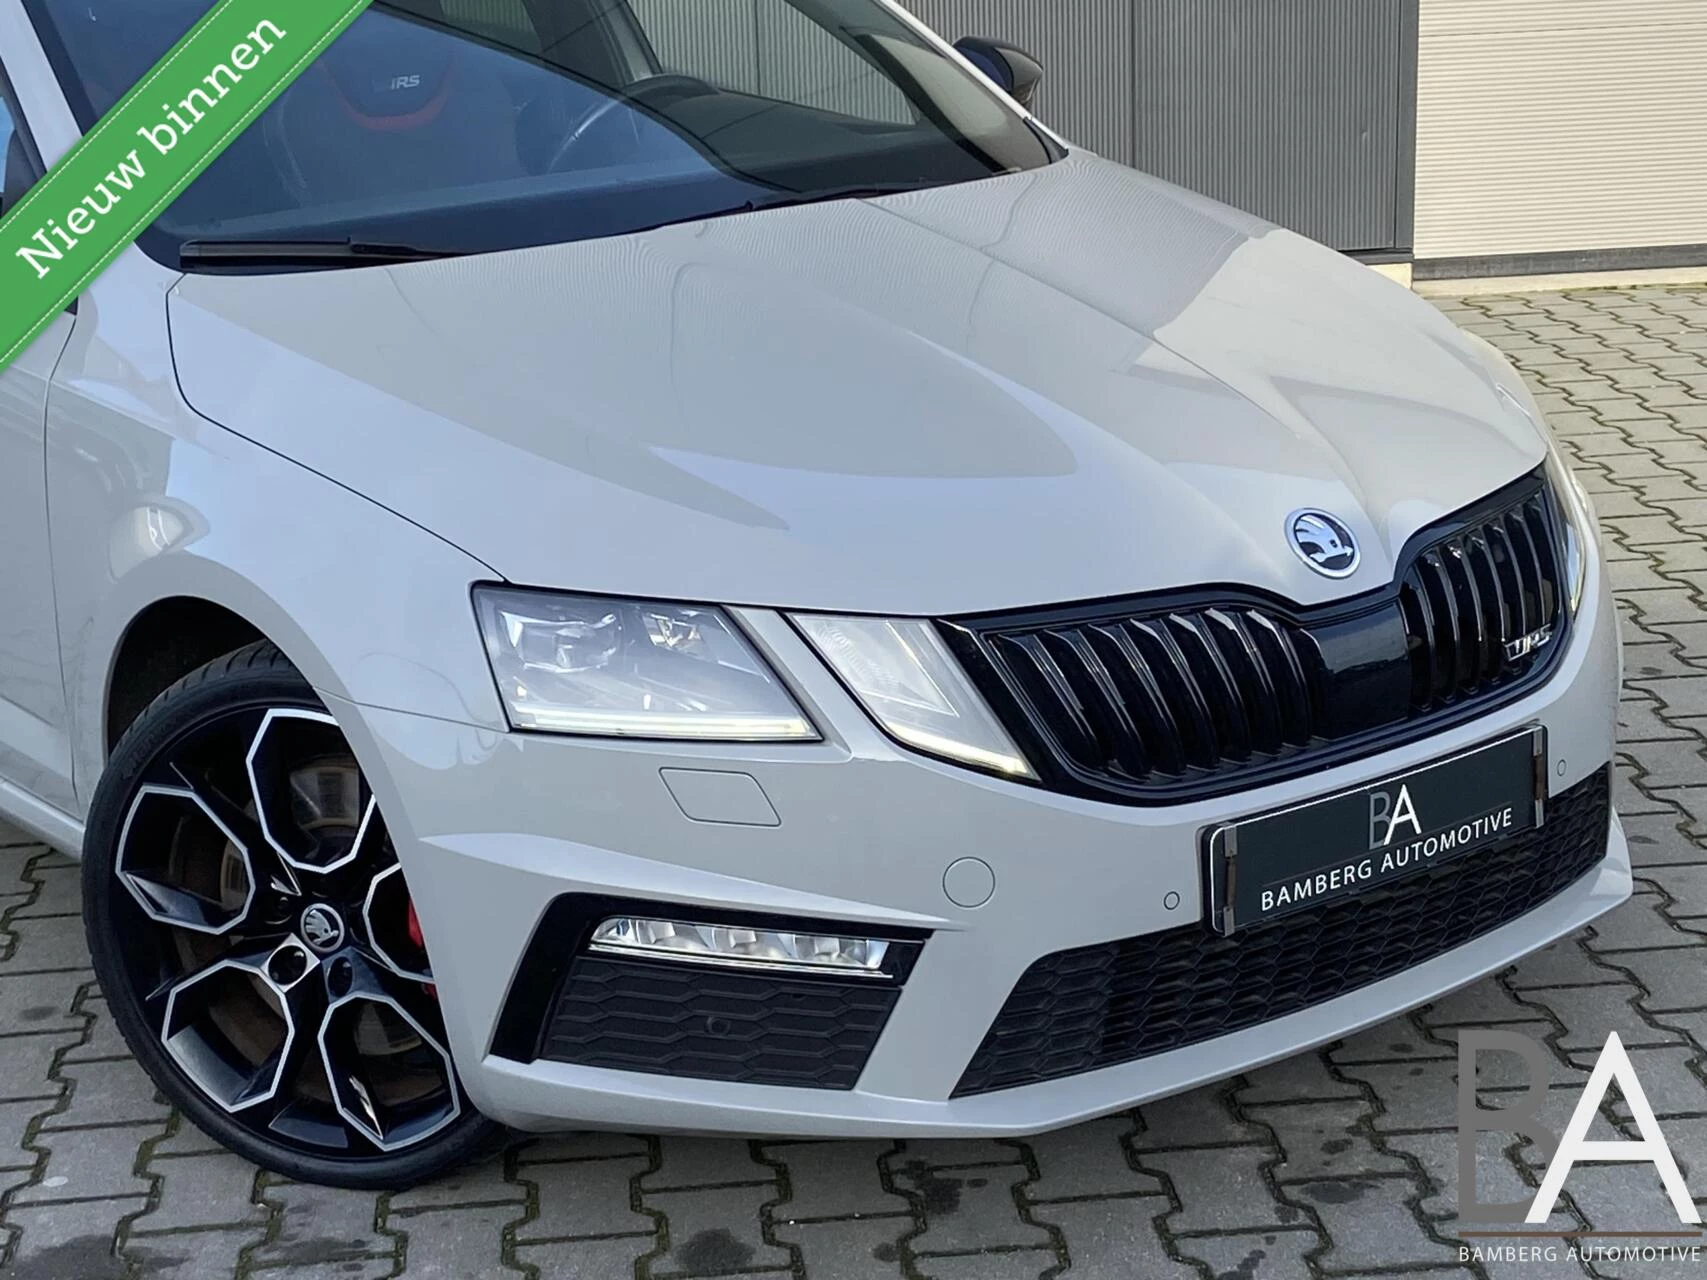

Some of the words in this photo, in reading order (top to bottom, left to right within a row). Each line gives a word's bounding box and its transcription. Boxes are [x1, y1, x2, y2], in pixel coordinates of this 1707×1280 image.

[1369, 784, 1422, 850] BA
[1262, 859, 1373, 912] BAMBERG
[1381, 808, 1513, 874] AUTOMOTIVE
